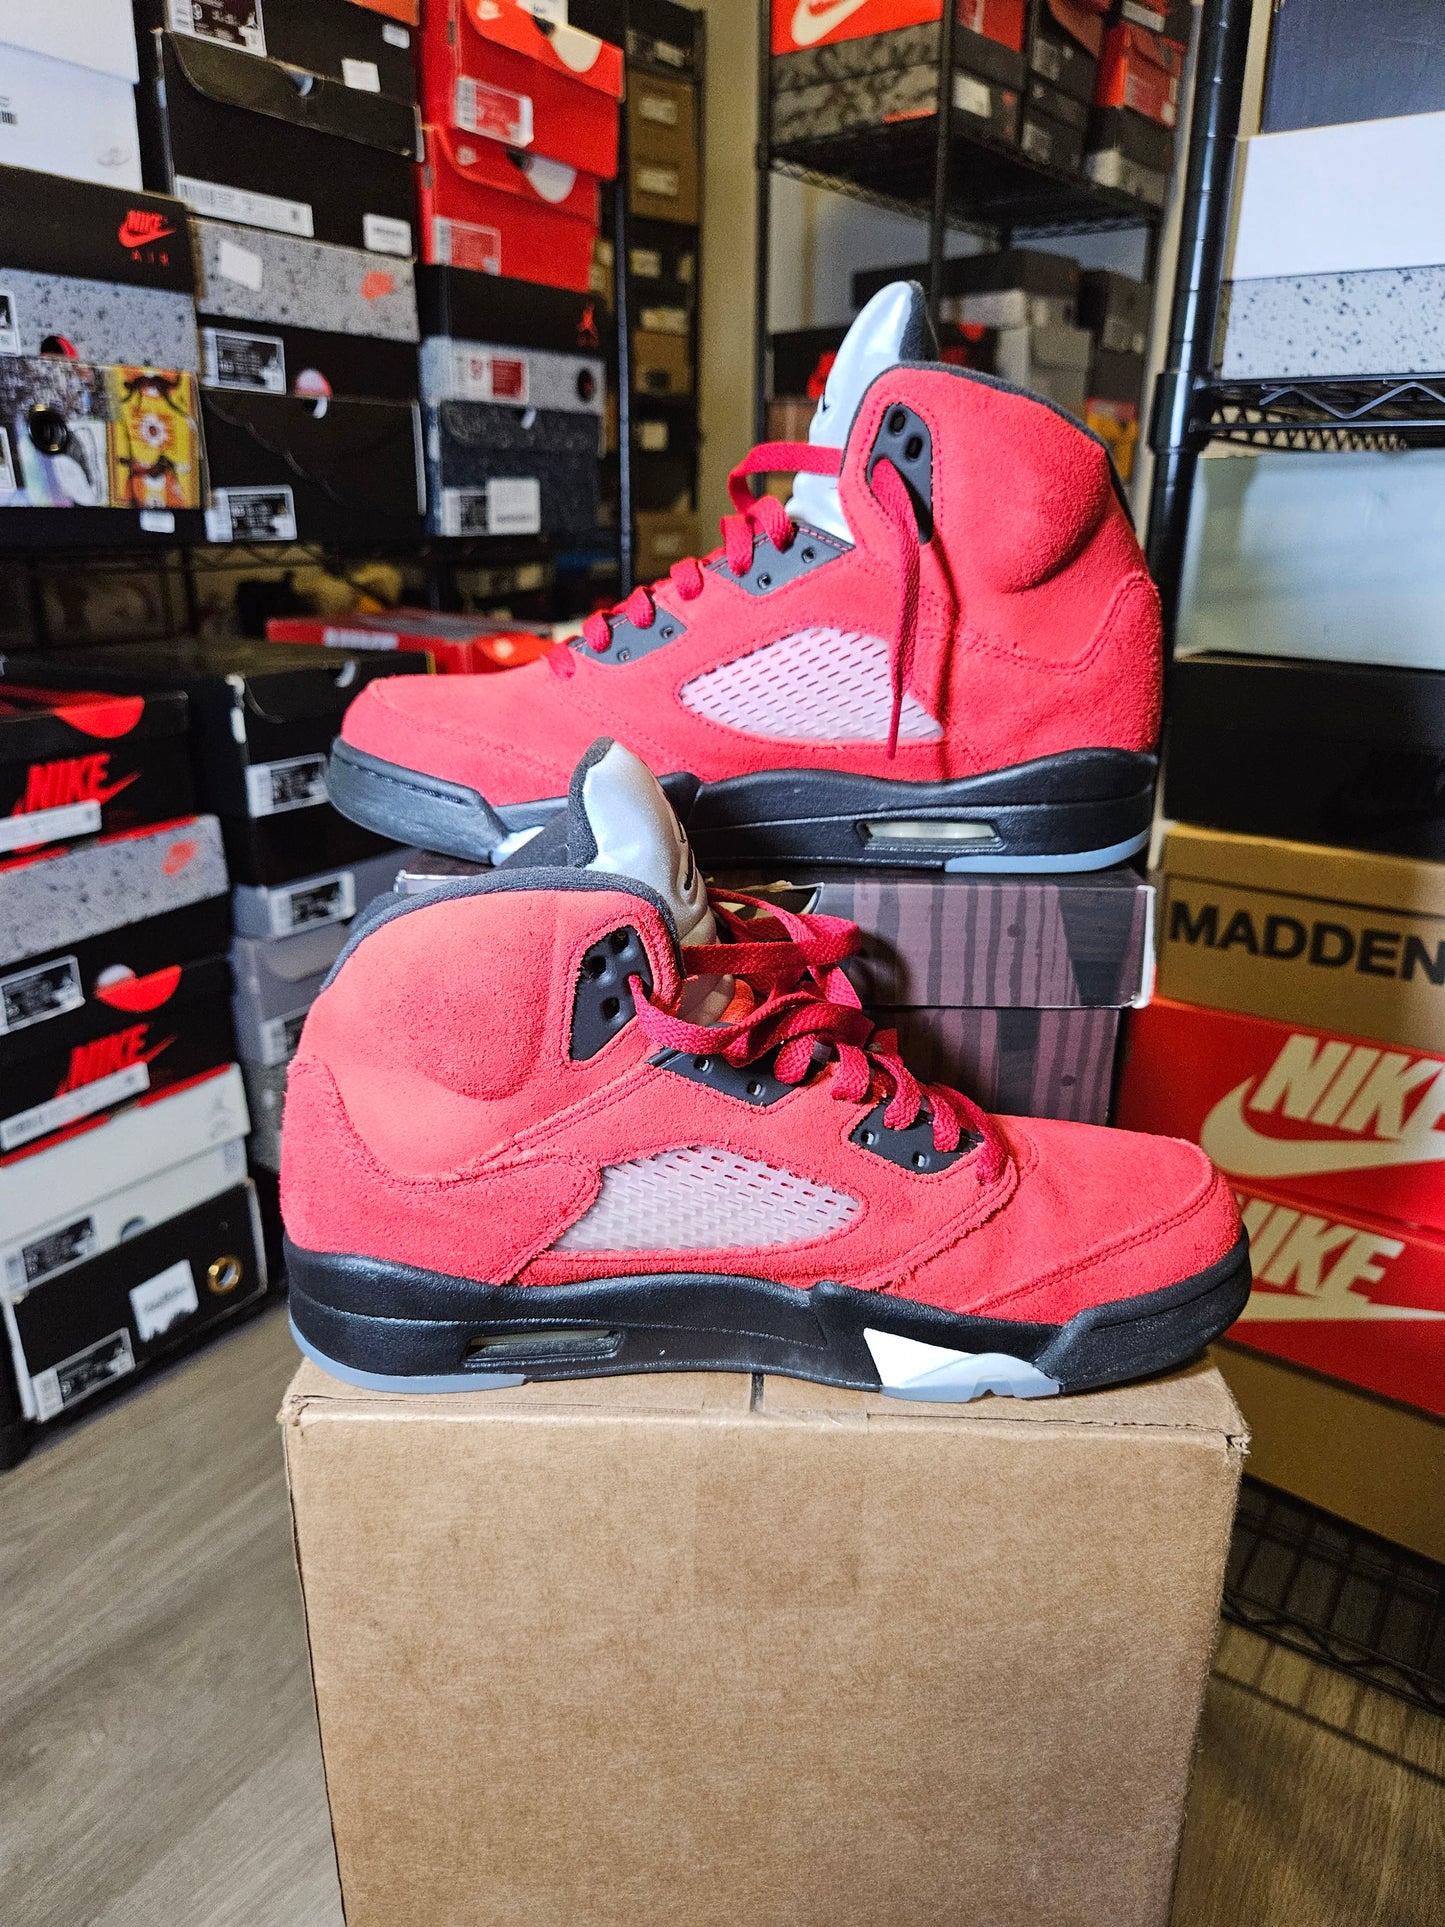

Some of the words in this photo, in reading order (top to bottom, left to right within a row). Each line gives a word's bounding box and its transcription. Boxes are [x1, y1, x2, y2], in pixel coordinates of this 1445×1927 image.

[26, 753, 110, 813] NIKE
[1169, 900, 1445, 986] MADDEN
[67, 1023, 149, 1091] NIKE
